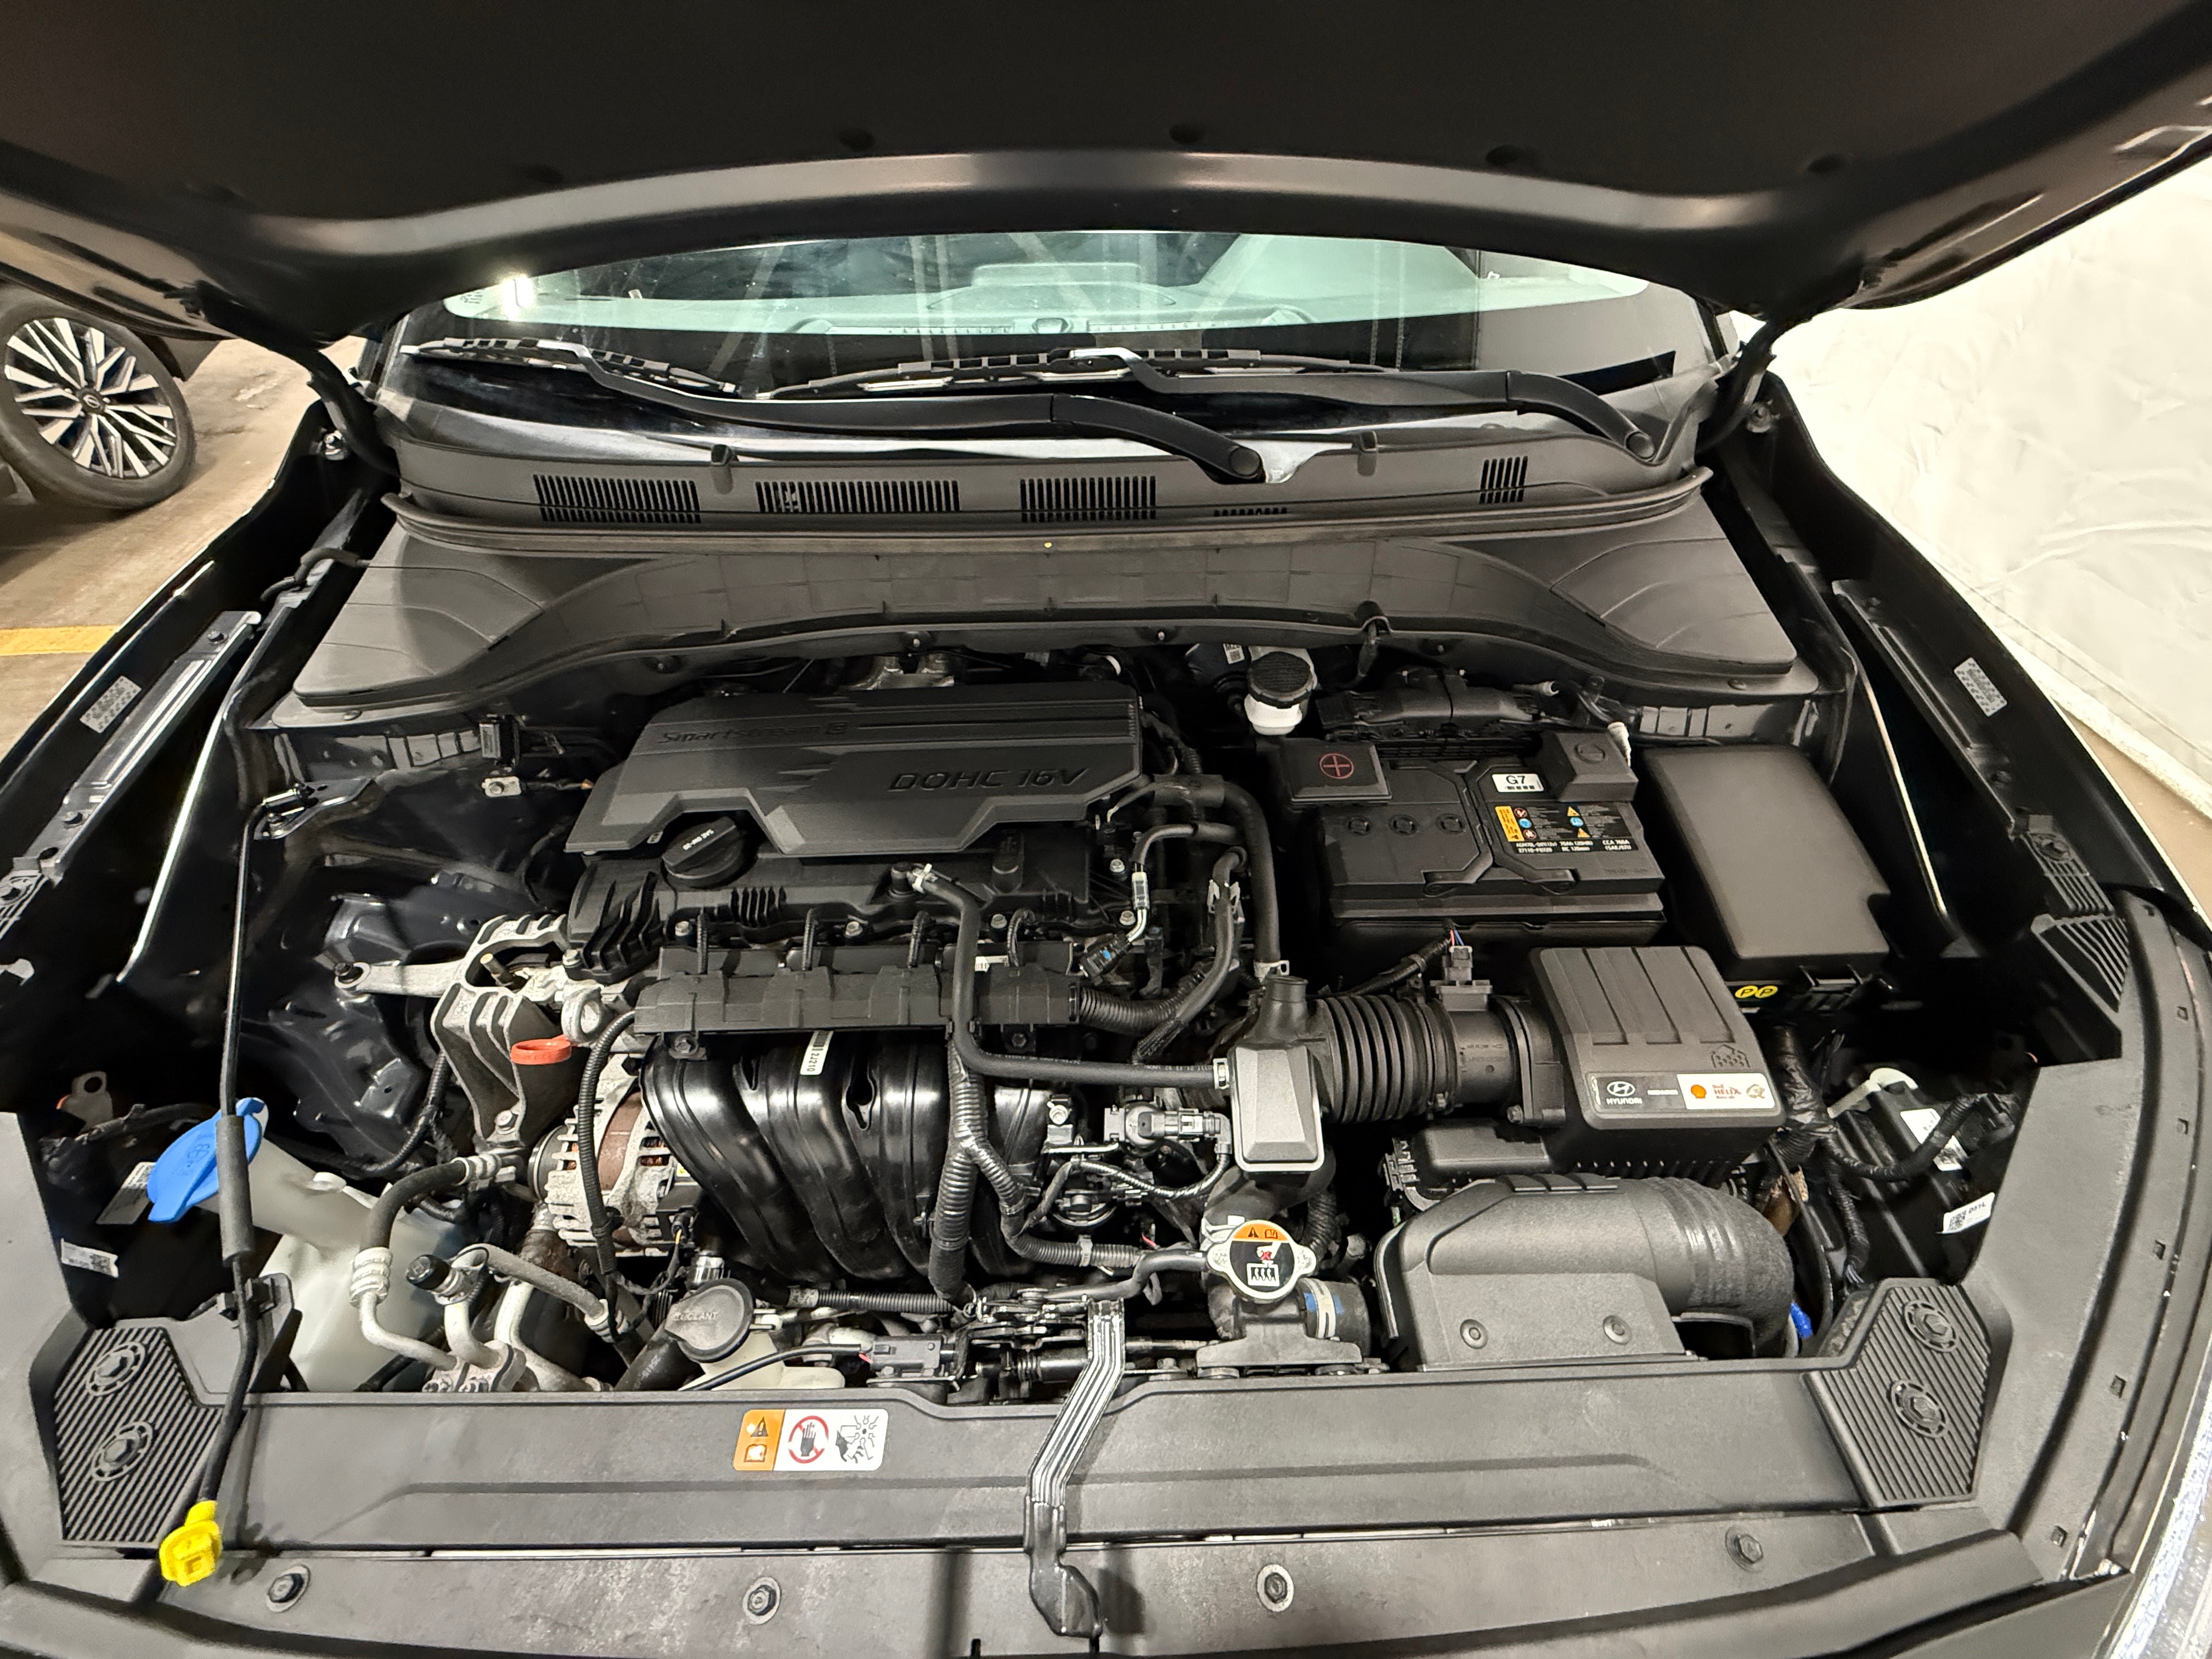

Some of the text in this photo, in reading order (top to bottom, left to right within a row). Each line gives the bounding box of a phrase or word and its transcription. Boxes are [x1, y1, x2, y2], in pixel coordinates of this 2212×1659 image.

[887, 768, 1088, 792] DOHC 16V
[1506, 775, 1526, 785] G7
[1740, 988, 1774, 996] P P
[806, 1052, 820, 1072] 2J210
